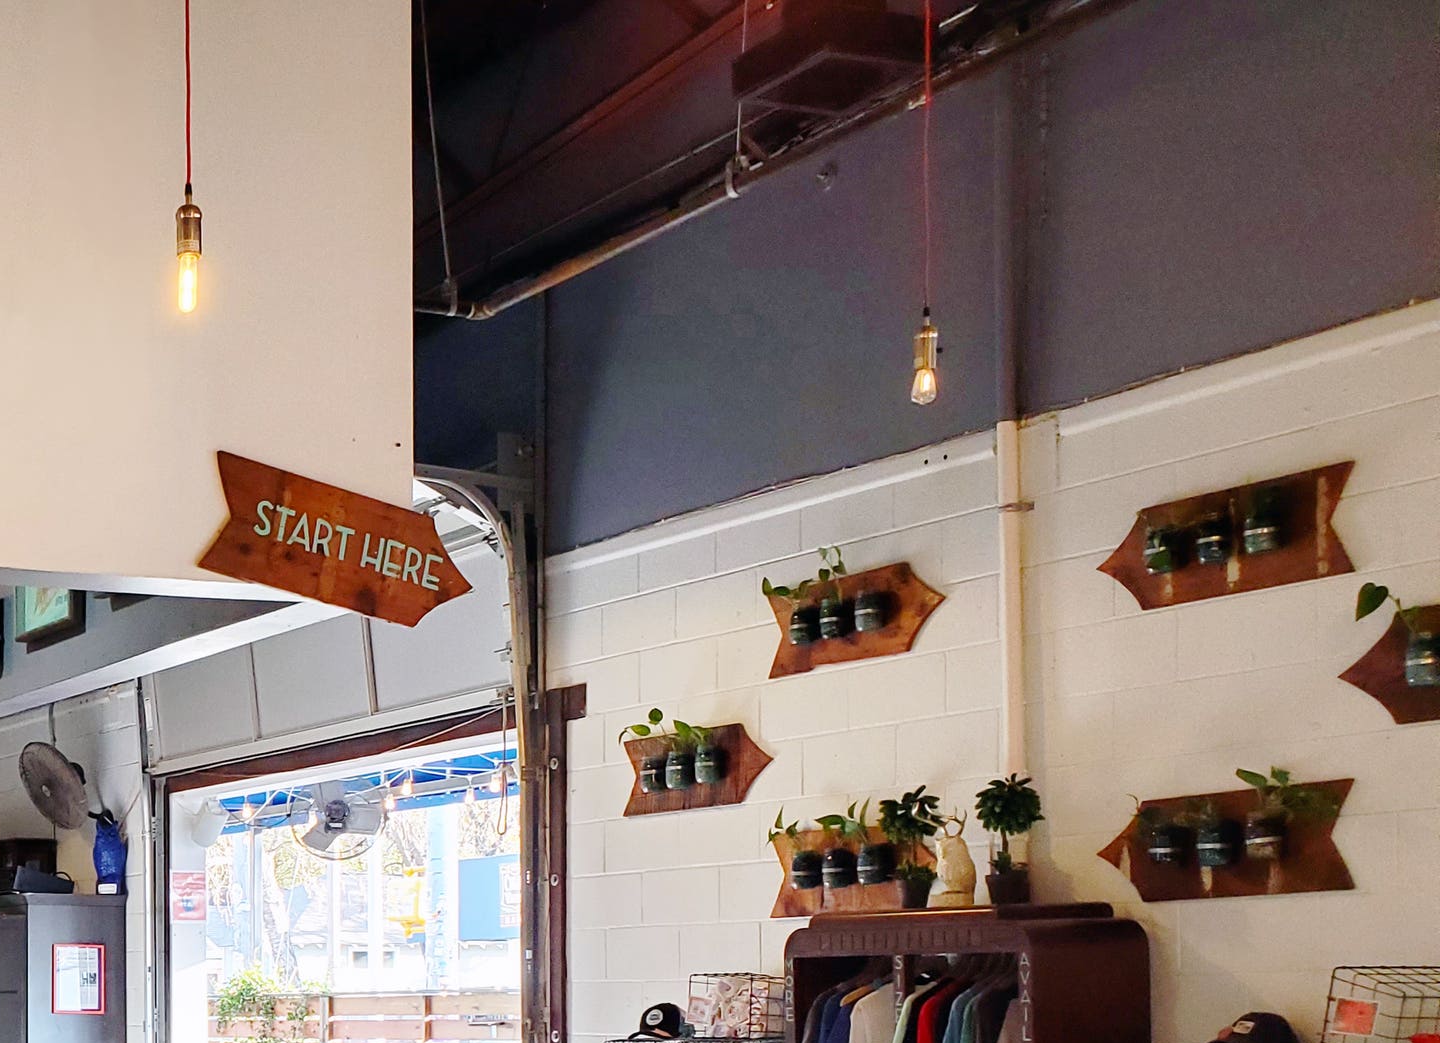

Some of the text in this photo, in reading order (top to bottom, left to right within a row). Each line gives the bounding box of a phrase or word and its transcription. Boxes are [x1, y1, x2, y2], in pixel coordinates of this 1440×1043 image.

[253, 500, 443, 592] START HERE
[784, 958, 795, 1023] MORE
